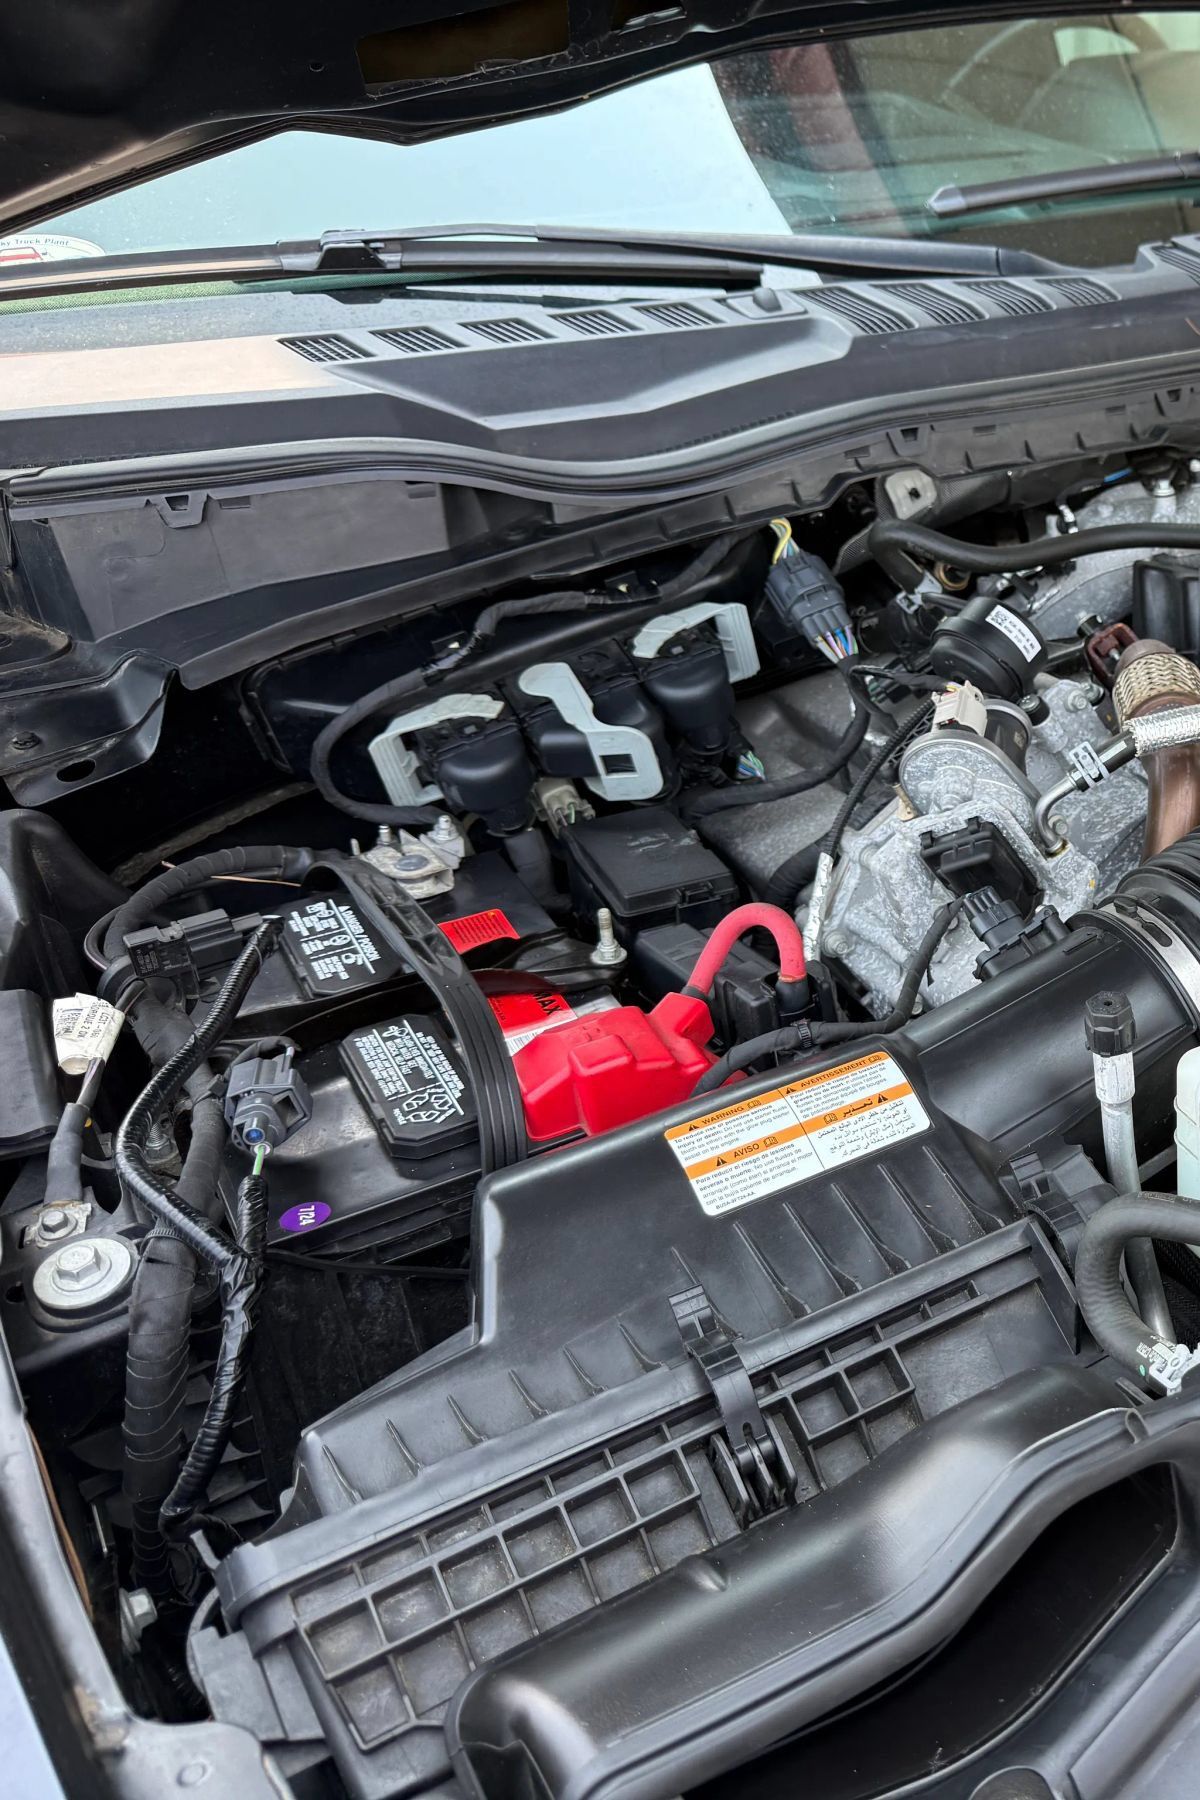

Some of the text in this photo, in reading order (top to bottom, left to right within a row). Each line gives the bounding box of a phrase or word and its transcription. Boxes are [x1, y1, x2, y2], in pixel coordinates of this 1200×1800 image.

[45, 238, 69, 246] Plant
[341, 910, 364, 934] DANGER
[358, 938, 380, 961] POISON
[402, 1035, 413, 1047] FLUSH
[409, 1046, 419, 1056] EYES
[394, 1055, 405, 1065] HELP
[801, 1059, 865, 1088] AVERTISSEMENT
[790, 1091, 804, 1099] Pour
[793, 1094, 812, 1104] graves
[820, 1096, 839, 1105] moteur
[865, 1077, 887, 1088] bougies
[682, 1130, 704, 1140] reduce
[750, 1104, 772, 1115] serious
[702, 1105, 744, 1125] WARNING
[677, 1140, 695, 1150] injury
[754, 1111, 771, 1120] starter
[772, 1105, 787, 1113] fluids
[680, 1145, 697, 1155] (such
[745, 1123, 759, 1131] glow
[759, 1117, 772, 1125] plug
[772, 1110, 790, 1119] starter
[683, 1151, 701, 1161] assist
[732, 1142, 760, 1158] AVISO
[695, 1175, 710, 1184] Para
[711, 1167, 732, 1178] reducir
[741, 1156, 760, 1167] riesgo
[769, 1142, 794, 1155] lesiones
[699, 1179, 723, 1192] severas
[775, 1151, 793, 1161] fluidos
[702, 1185, 729, 1200] arranque
[730, 1177, 748, 1188] (como
[769, 1160, 790, 1172] arranca
[797, 1151, 813, 1160] motor
[739, 1179, 761, 1192] caliente
[298, 1205, 315, 1225] 7/24
